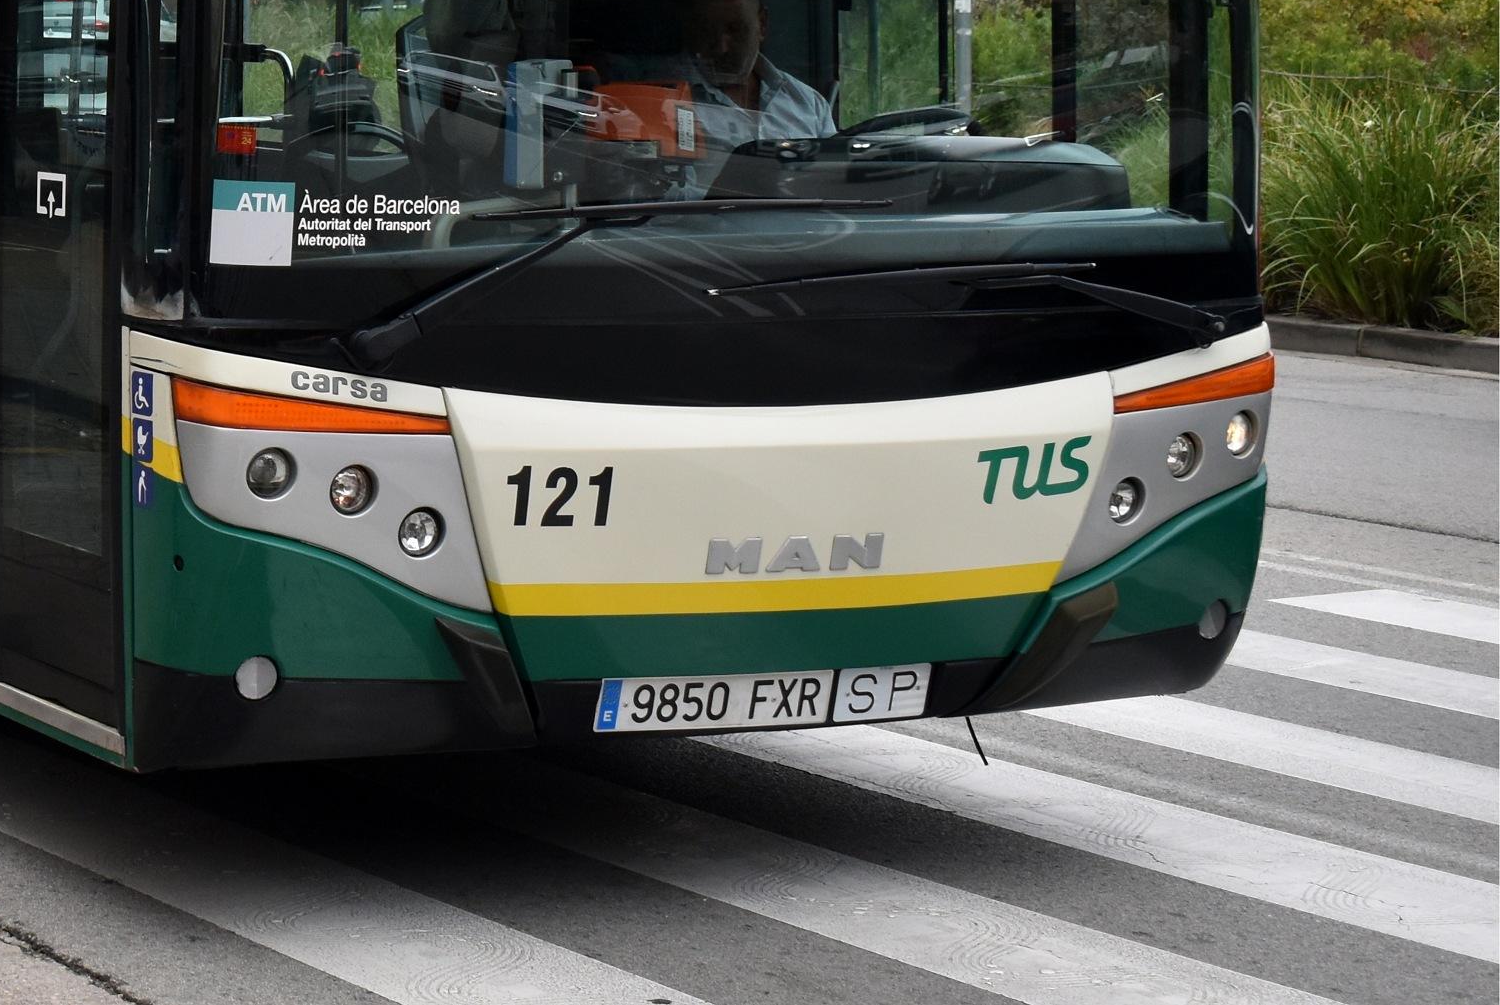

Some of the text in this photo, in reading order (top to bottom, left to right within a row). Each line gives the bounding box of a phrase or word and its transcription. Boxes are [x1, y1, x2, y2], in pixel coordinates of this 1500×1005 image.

[236, 192, 287, 212] ATM
[299, 189, 461, 215] Àrea de Barcelona
[297, 233, 366, 248] Metropolità
[298, 217, 432, 233] Autoritat del Transport
[290, 370, 388, 403] carsa
[976, 434, 1093, 504] TUS
[505, 465, 614, 527] 121
[705, 531, 886, 575] MAN
[602, 677, 821, 724] E 9850 FXR
